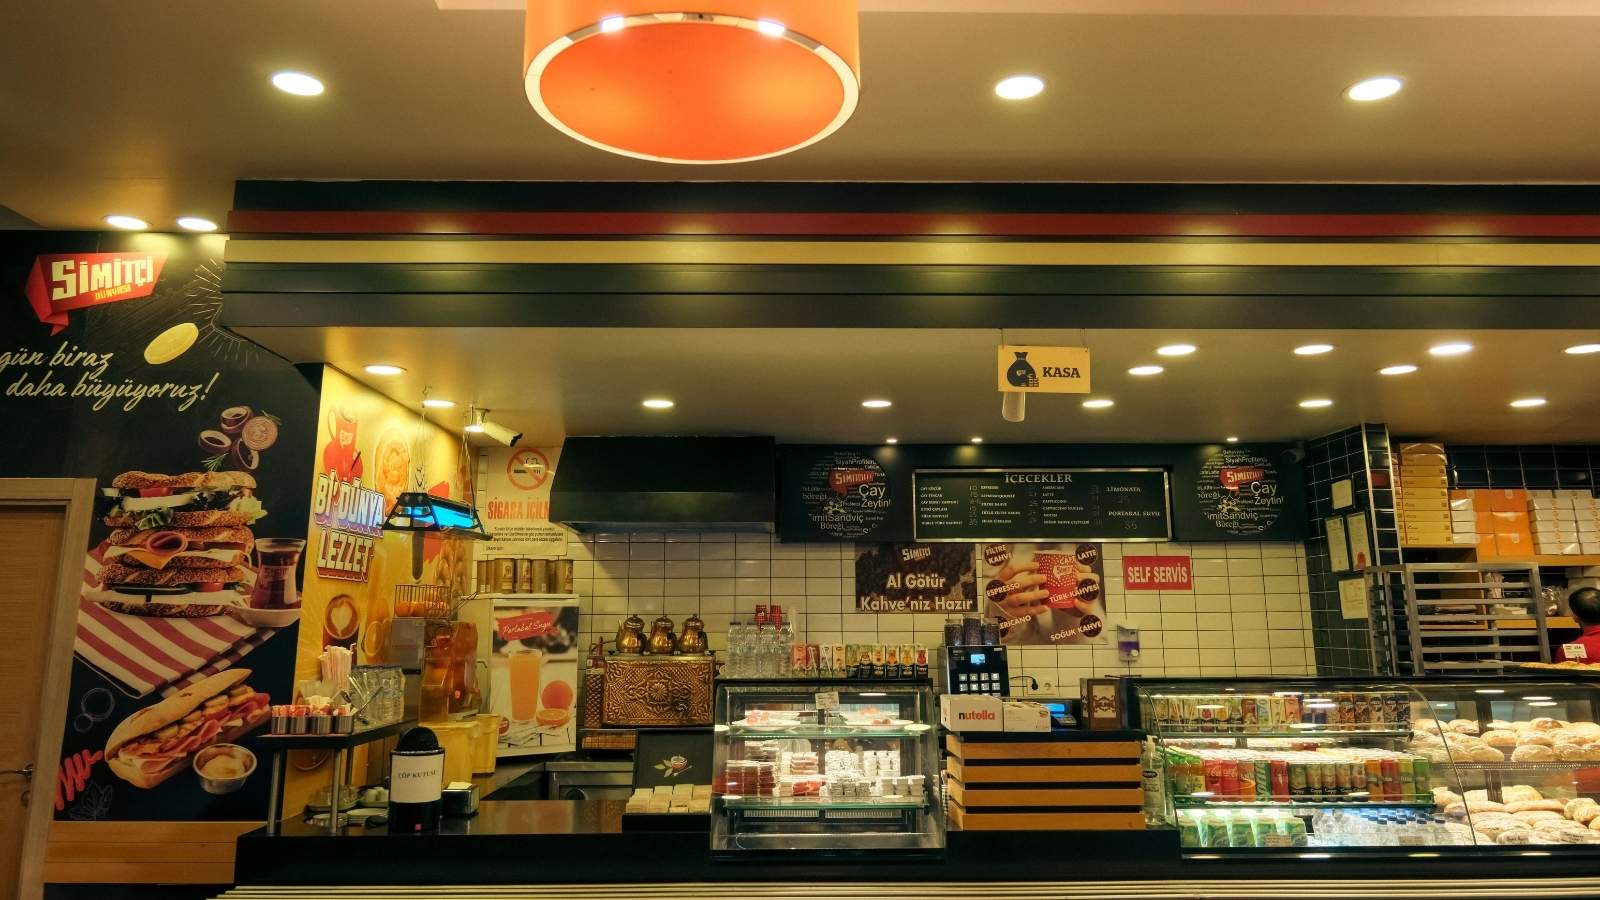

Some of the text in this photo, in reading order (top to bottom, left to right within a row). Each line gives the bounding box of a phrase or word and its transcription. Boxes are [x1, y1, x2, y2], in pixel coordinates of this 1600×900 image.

[49, 341, 114, 380] biraz
[1042, 366, 1081, 378] KASA
[6, 370, 220, 412] daha büyüyoruz!
[336, 477, 385, 528] DÜNYA
[317, 528, 375, 573] LEZZET
[1077, 549, 1097, 560] LATTE
[886, 572, 946, 589] Al Götür
[1128, 563, 1188, 583] SELF SERVİS
[986, 582, 1021, 597] ESPRESSO
[861, 595, 973, 611] Kahve'niz Hazır
[1000, 614, 1032, 629] ERICANO
[1050, 619, 1102, 641] SOĞUK KAHVE
[958, 710, 996, 721] nutella
